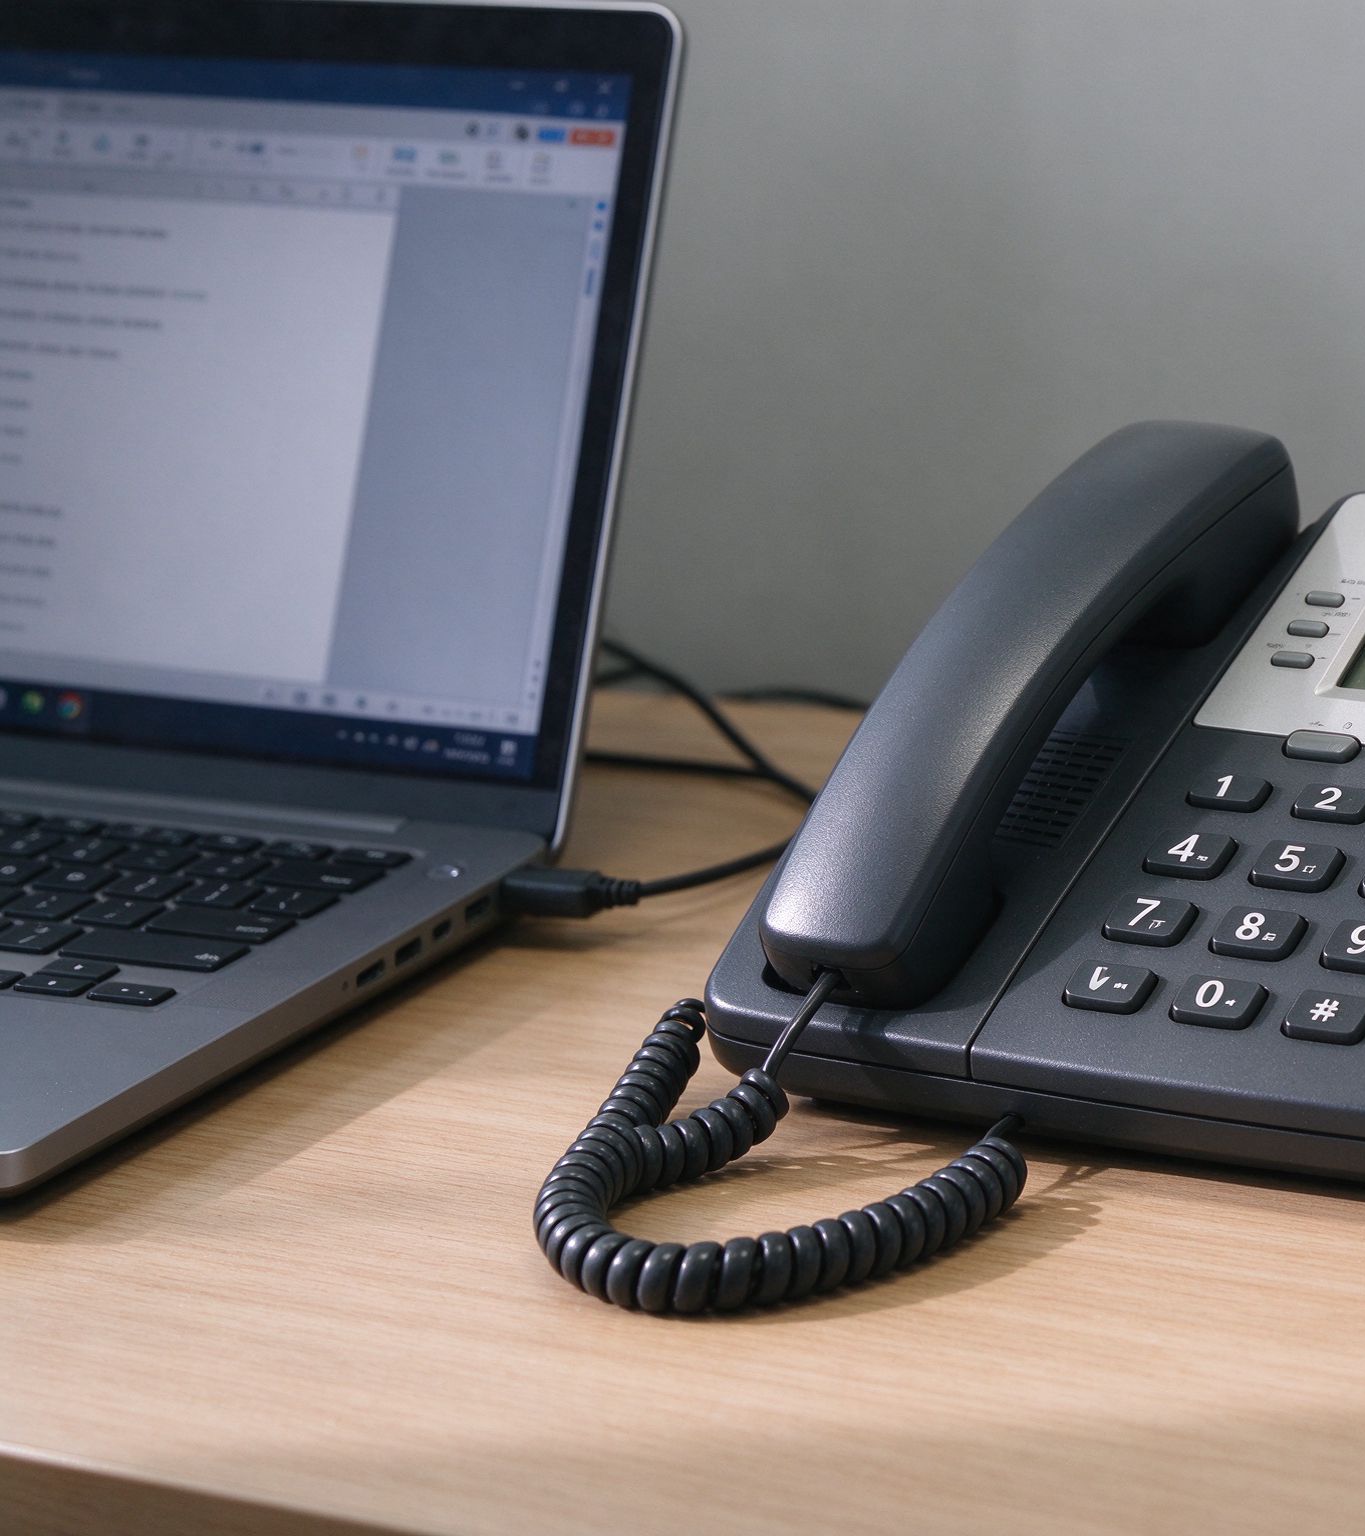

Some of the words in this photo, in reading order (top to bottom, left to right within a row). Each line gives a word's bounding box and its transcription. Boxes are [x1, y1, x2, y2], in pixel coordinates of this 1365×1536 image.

[1217, 775, 1234, 797] 1
[1314, 787, 1342, 811] 2
[1168, 834, 1199, 862] 4
[1274, 845, 1306, 872] 5
[1128, 898, 1161, 927] 7
[1235, 912, 1265, 940] 8
[1195, 980, 1224, 1007] 0
[1310, 999, 1339, 1022] #
